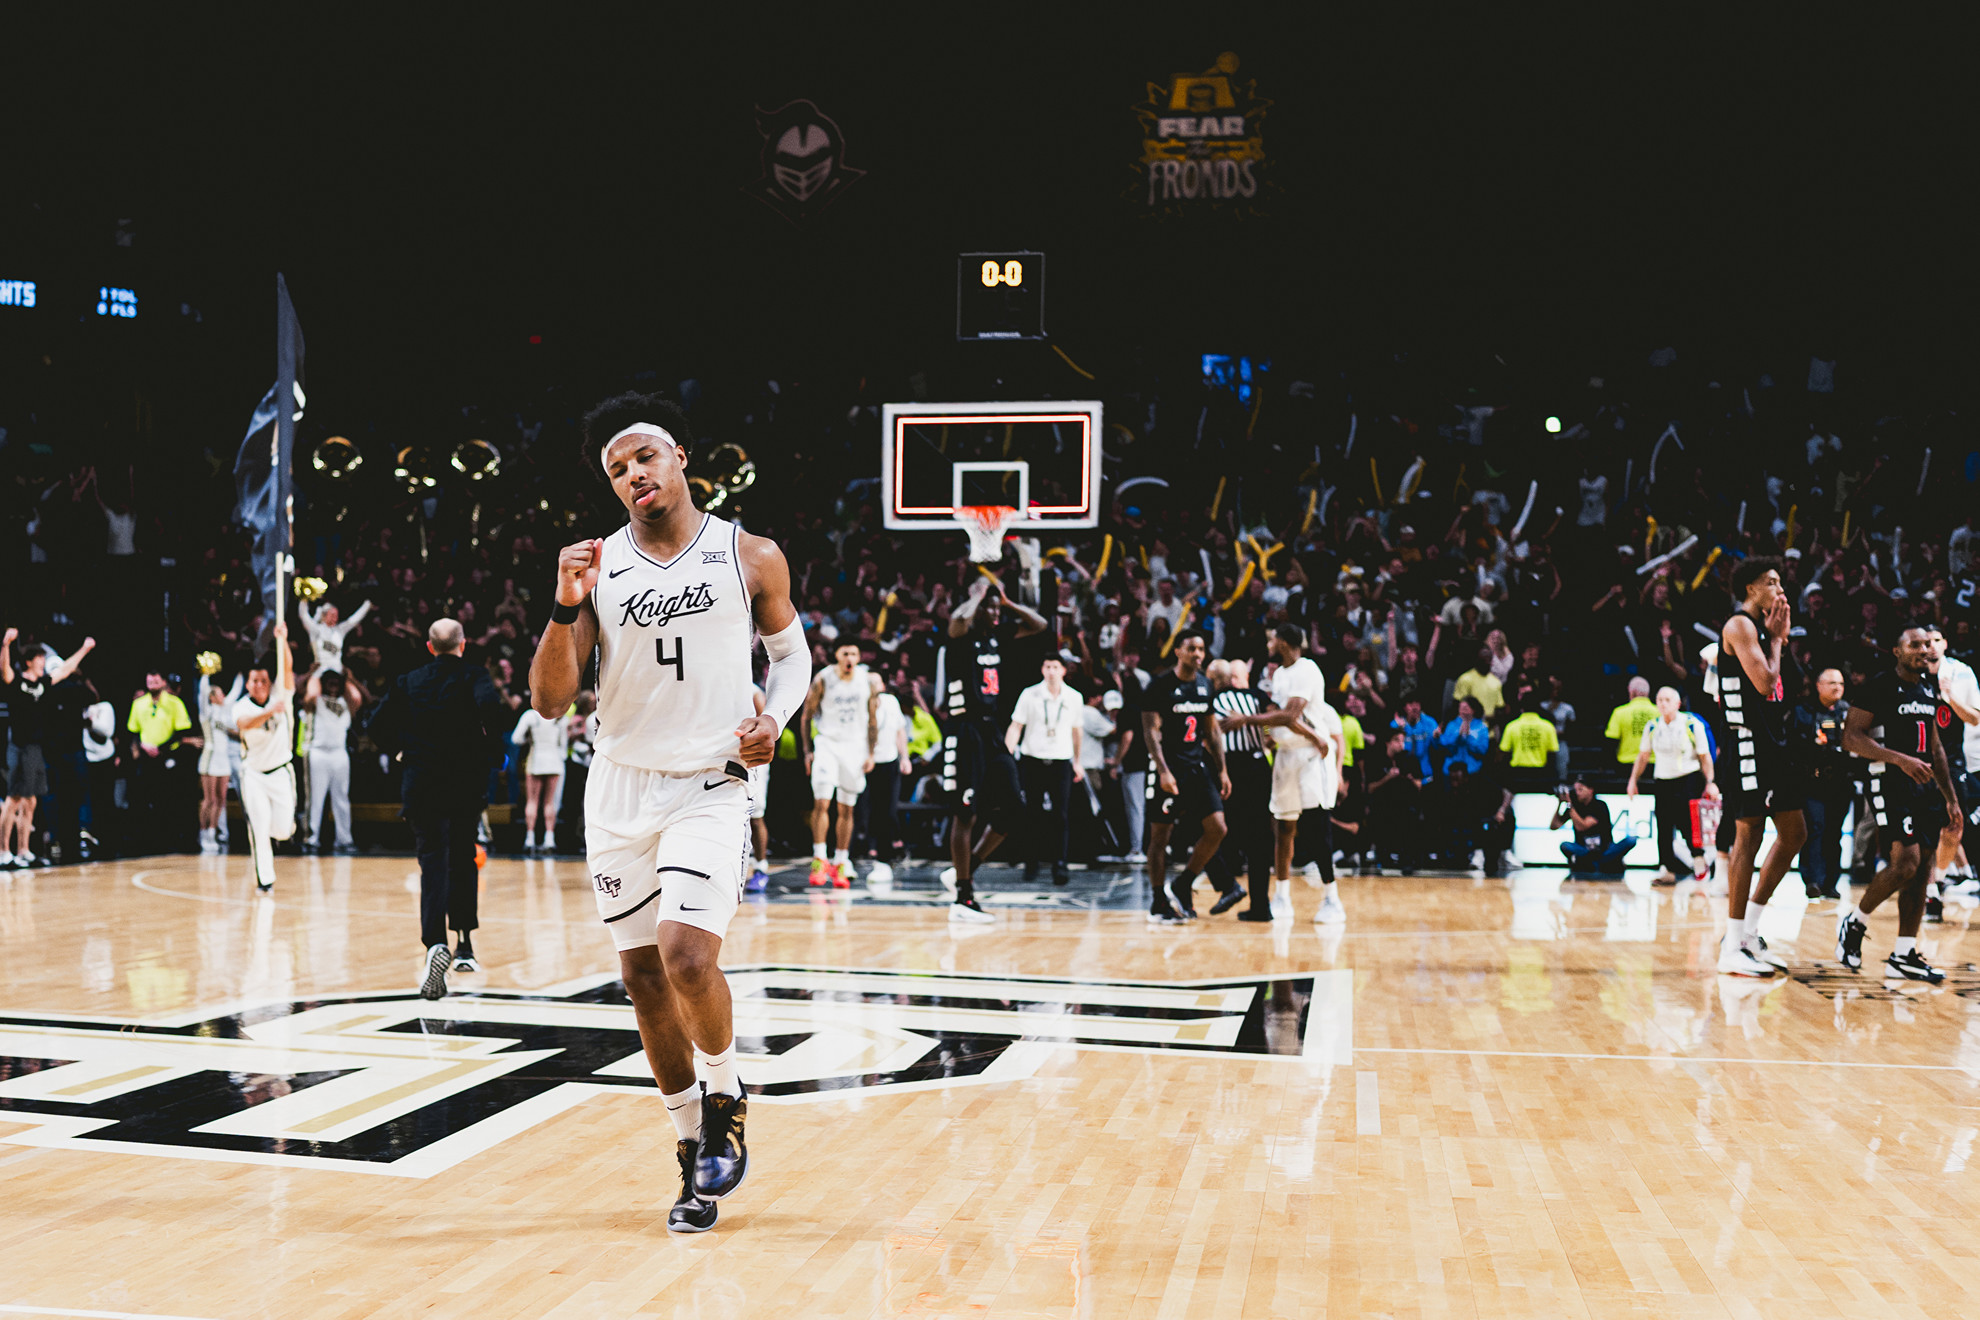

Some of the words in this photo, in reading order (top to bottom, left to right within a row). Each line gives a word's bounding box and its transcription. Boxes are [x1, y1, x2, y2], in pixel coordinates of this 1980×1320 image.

[1158, 116, 1244, 138] FEAR
[1148, 159, 1257, 206] FRONDS
[619, 582, 718, 627] Knights
[656, 637, 684, 681] 4
[1183, 715, 1197, 742] 2
[1916, 720, 1926, 752] 1
[594, 873, 622, 898] UCF
